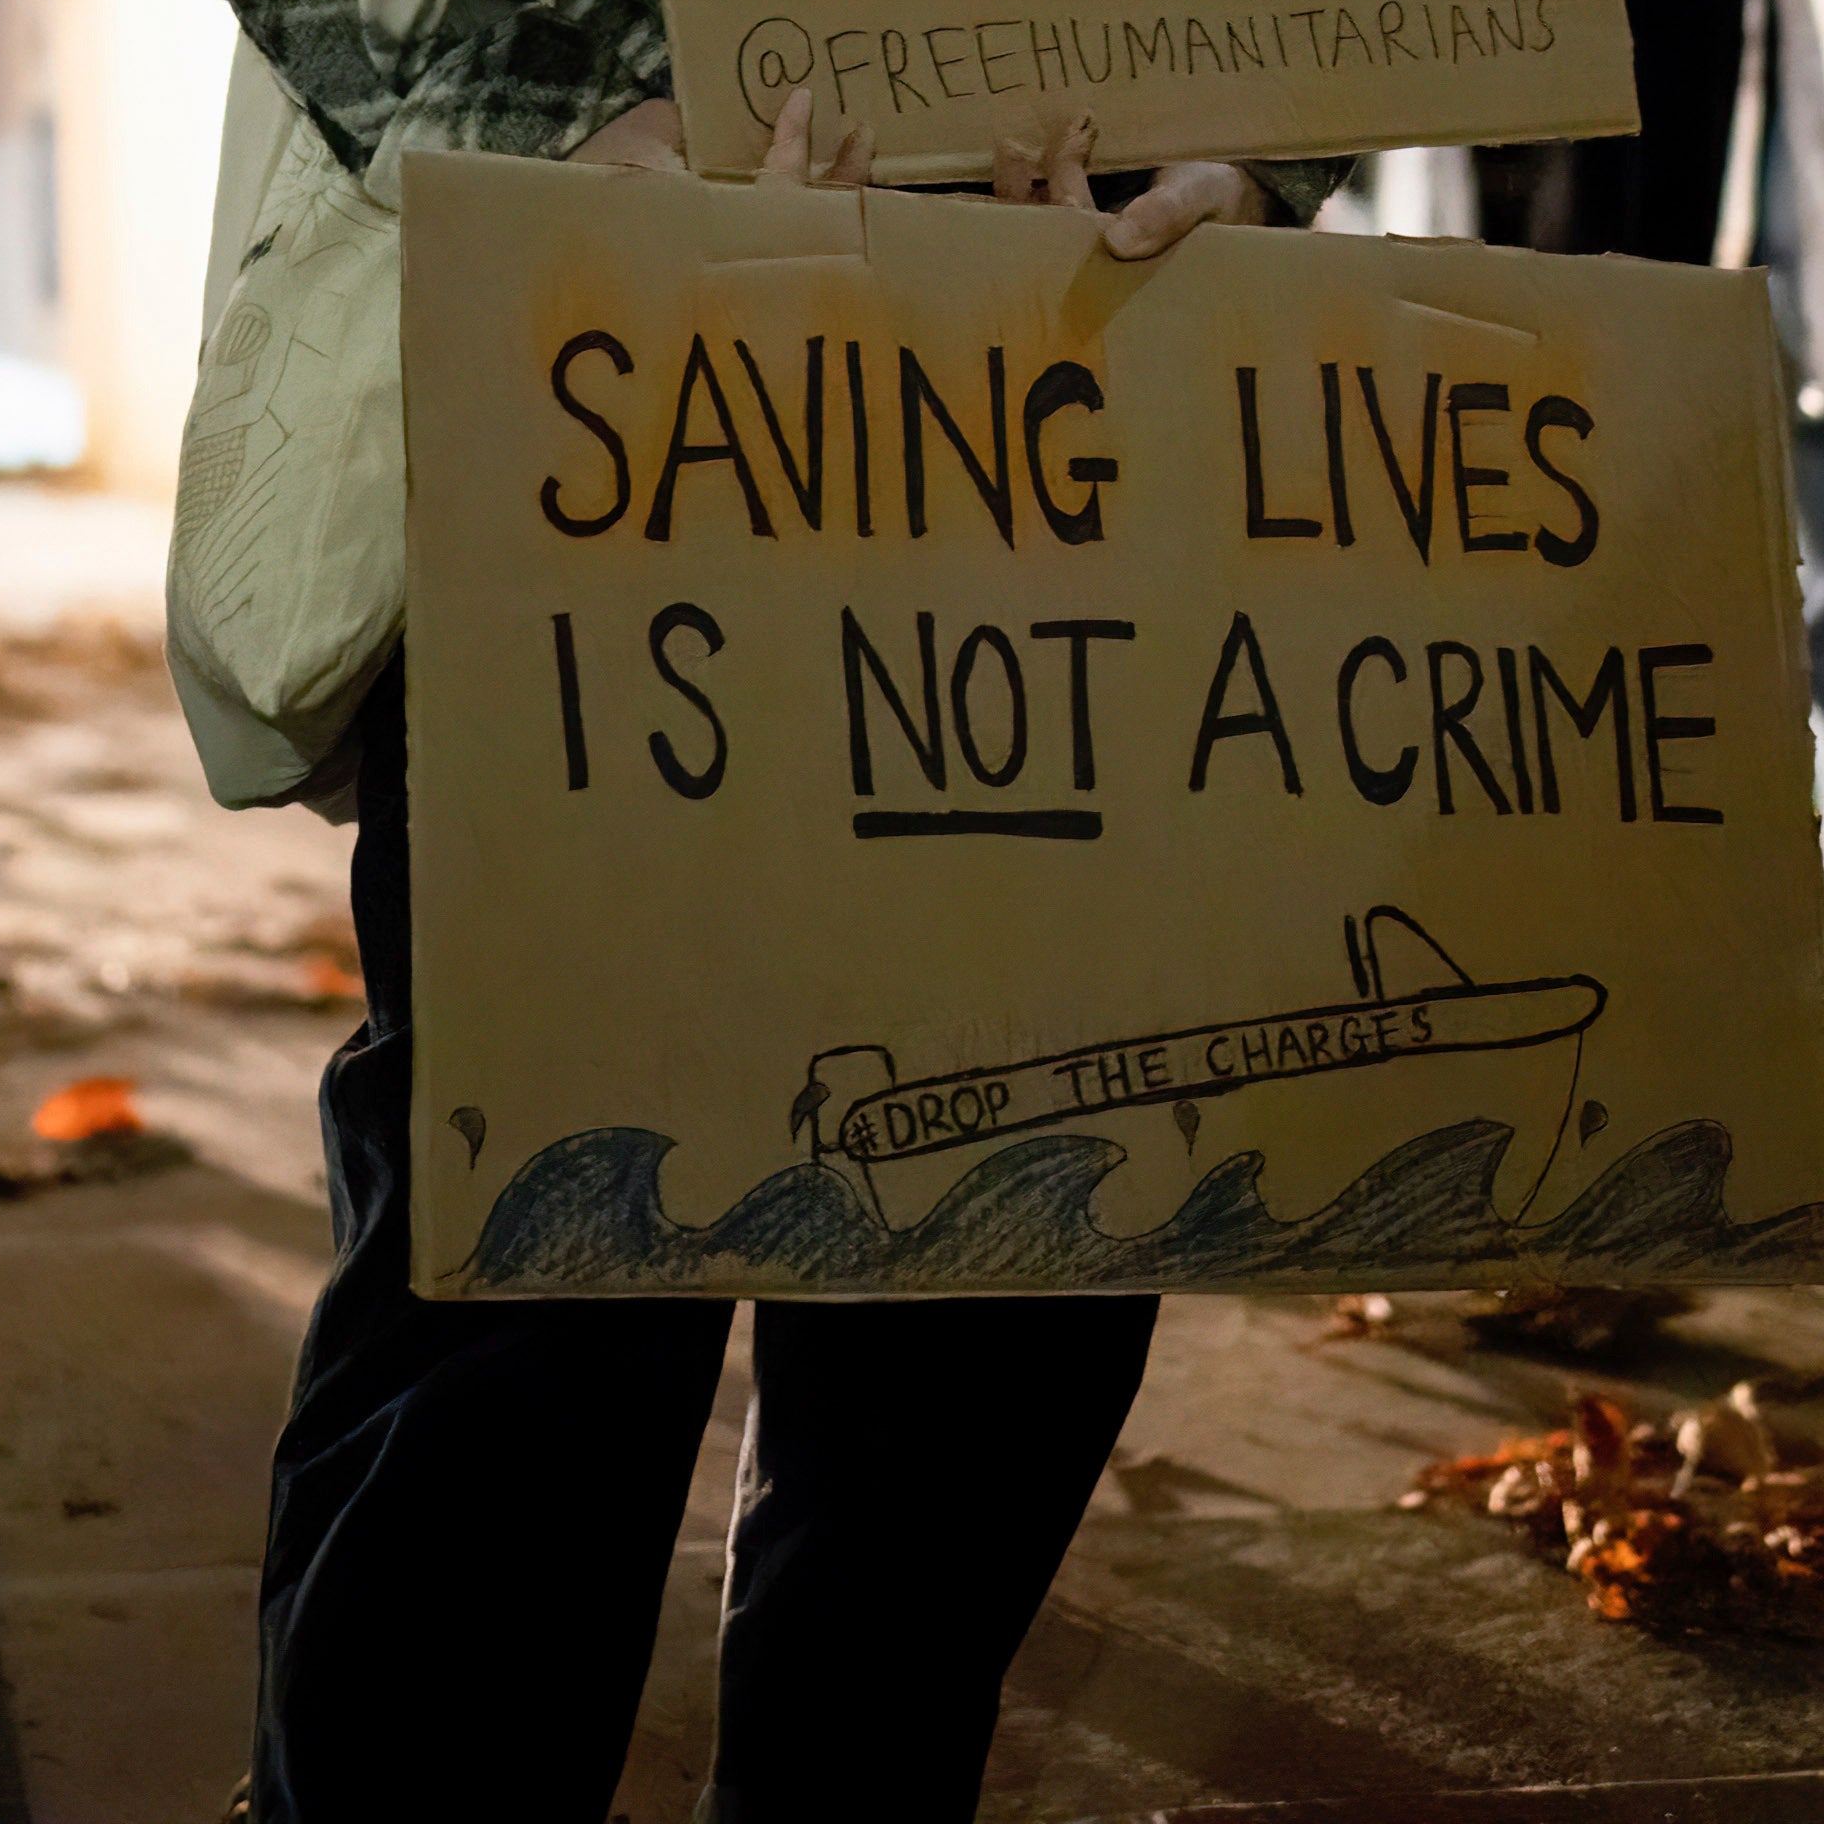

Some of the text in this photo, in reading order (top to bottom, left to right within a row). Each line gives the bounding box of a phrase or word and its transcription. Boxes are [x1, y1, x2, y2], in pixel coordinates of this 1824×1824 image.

[539, 328, 1600, 568] SAVING LIVES
[550, 601, 1724, 824] IS NOT A CRIME
[850, 1007, 1434, 1154] #DROP THE CHARGES
